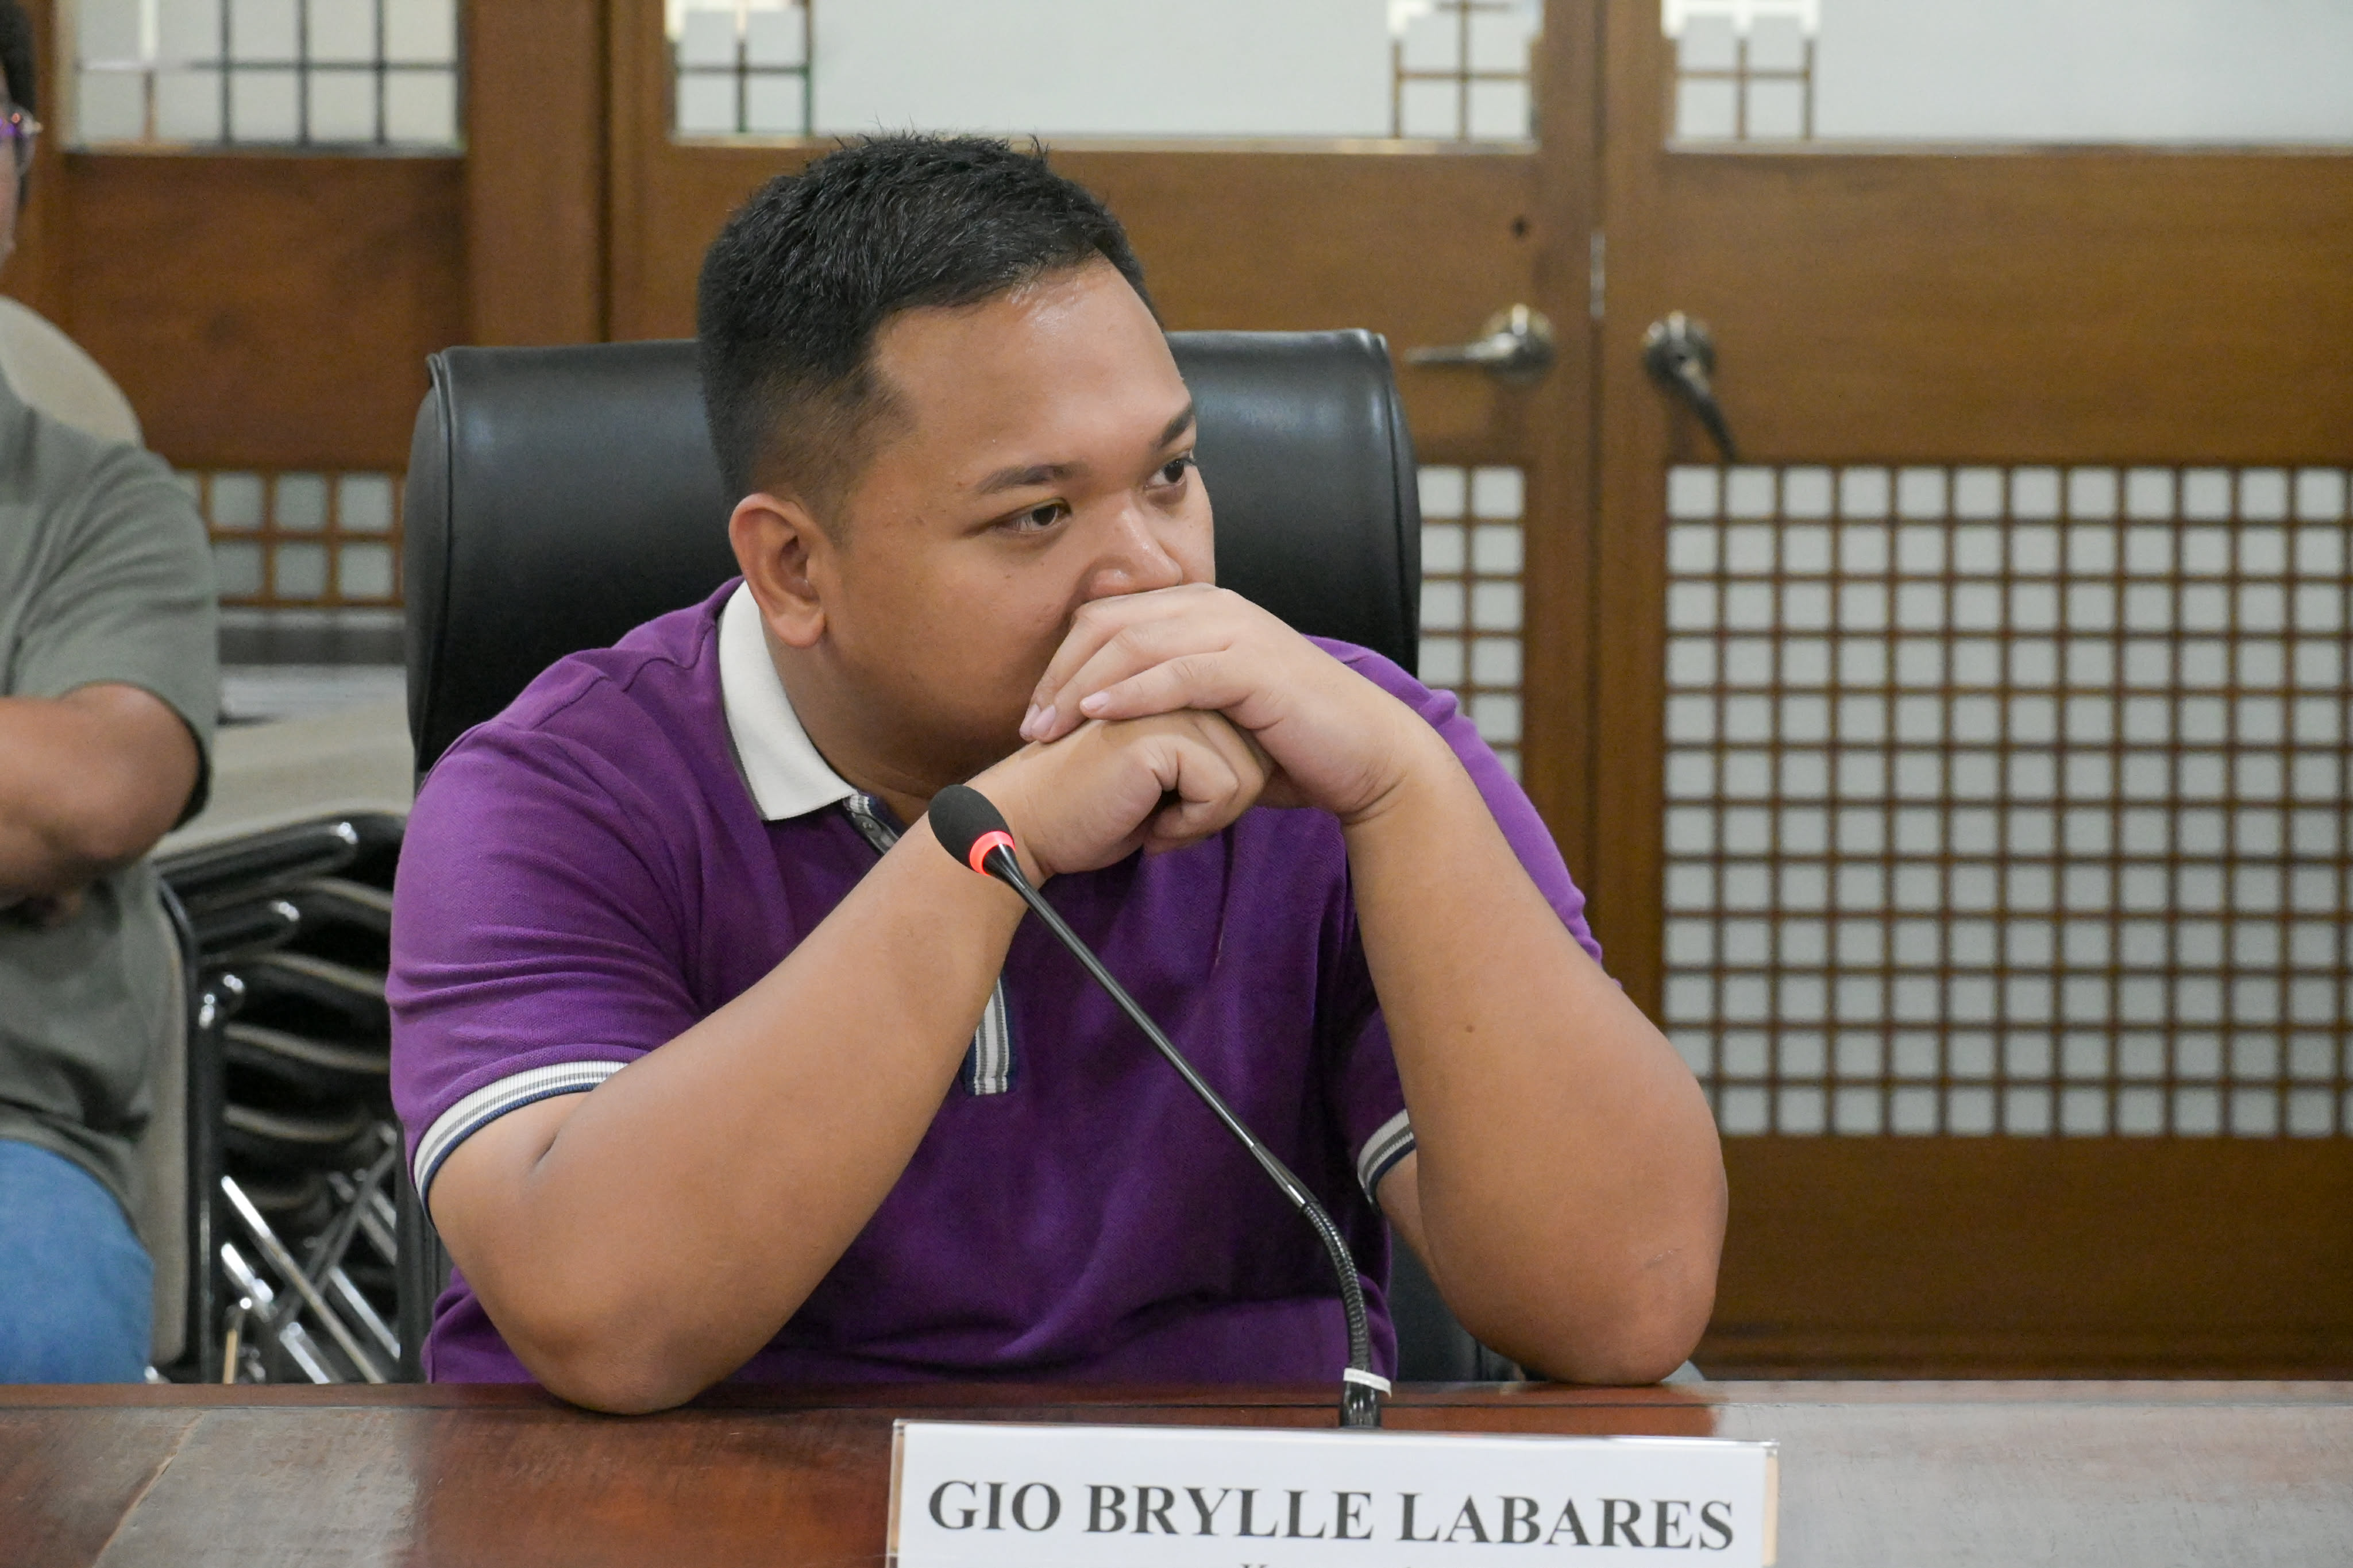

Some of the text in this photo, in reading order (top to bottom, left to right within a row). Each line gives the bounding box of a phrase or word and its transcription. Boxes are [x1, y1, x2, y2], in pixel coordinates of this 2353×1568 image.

[928, 1480, 1734, 1550] GIO BRYLLE LABARES
